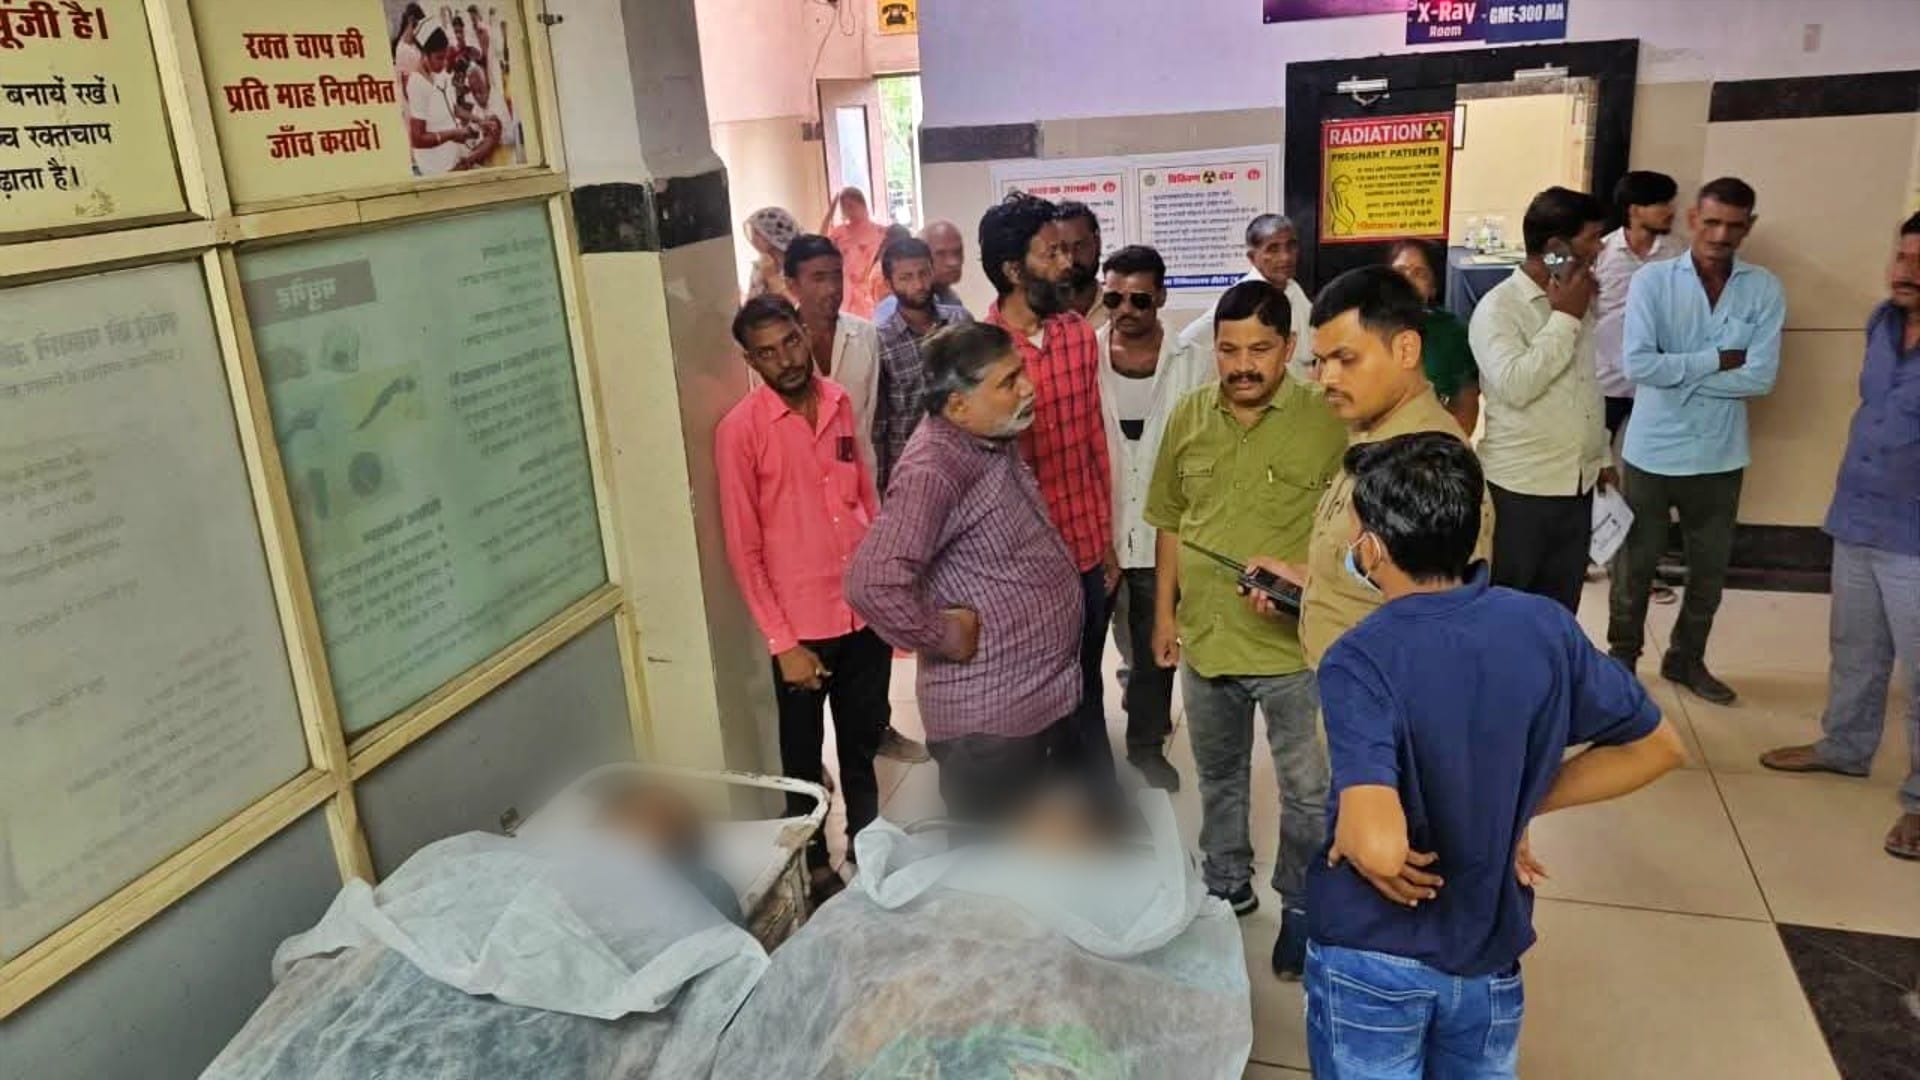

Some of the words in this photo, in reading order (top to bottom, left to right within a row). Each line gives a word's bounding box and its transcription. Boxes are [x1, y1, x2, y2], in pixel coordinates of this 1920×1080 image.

[1489, 4, 1543, 24] GME-300
[1545, 3, 1564, 21] MA
[242, 33, 289, 59] रक्त
[293, 34, 335, 58] चाप
[336, 27, 365, 59] की
[1429, 25, 1462, 37] Room
[2, 75, 67, 106] बनायें
[224, 77, 270, 113] प्रति
[274, 83, 316, 108] माह
[319, 74, 396, 107] नियमित
[24, 123, 113, 148] रक्तचाप
[266, 124, 315, 159] जाँच
[1329, 122, 1423, 145] RADIATION
[1331, 150, 1387, 162] PREGNANT
[1389, 146, 1440, 159] PATIENTS
[47, 157, 80, 192] है।
